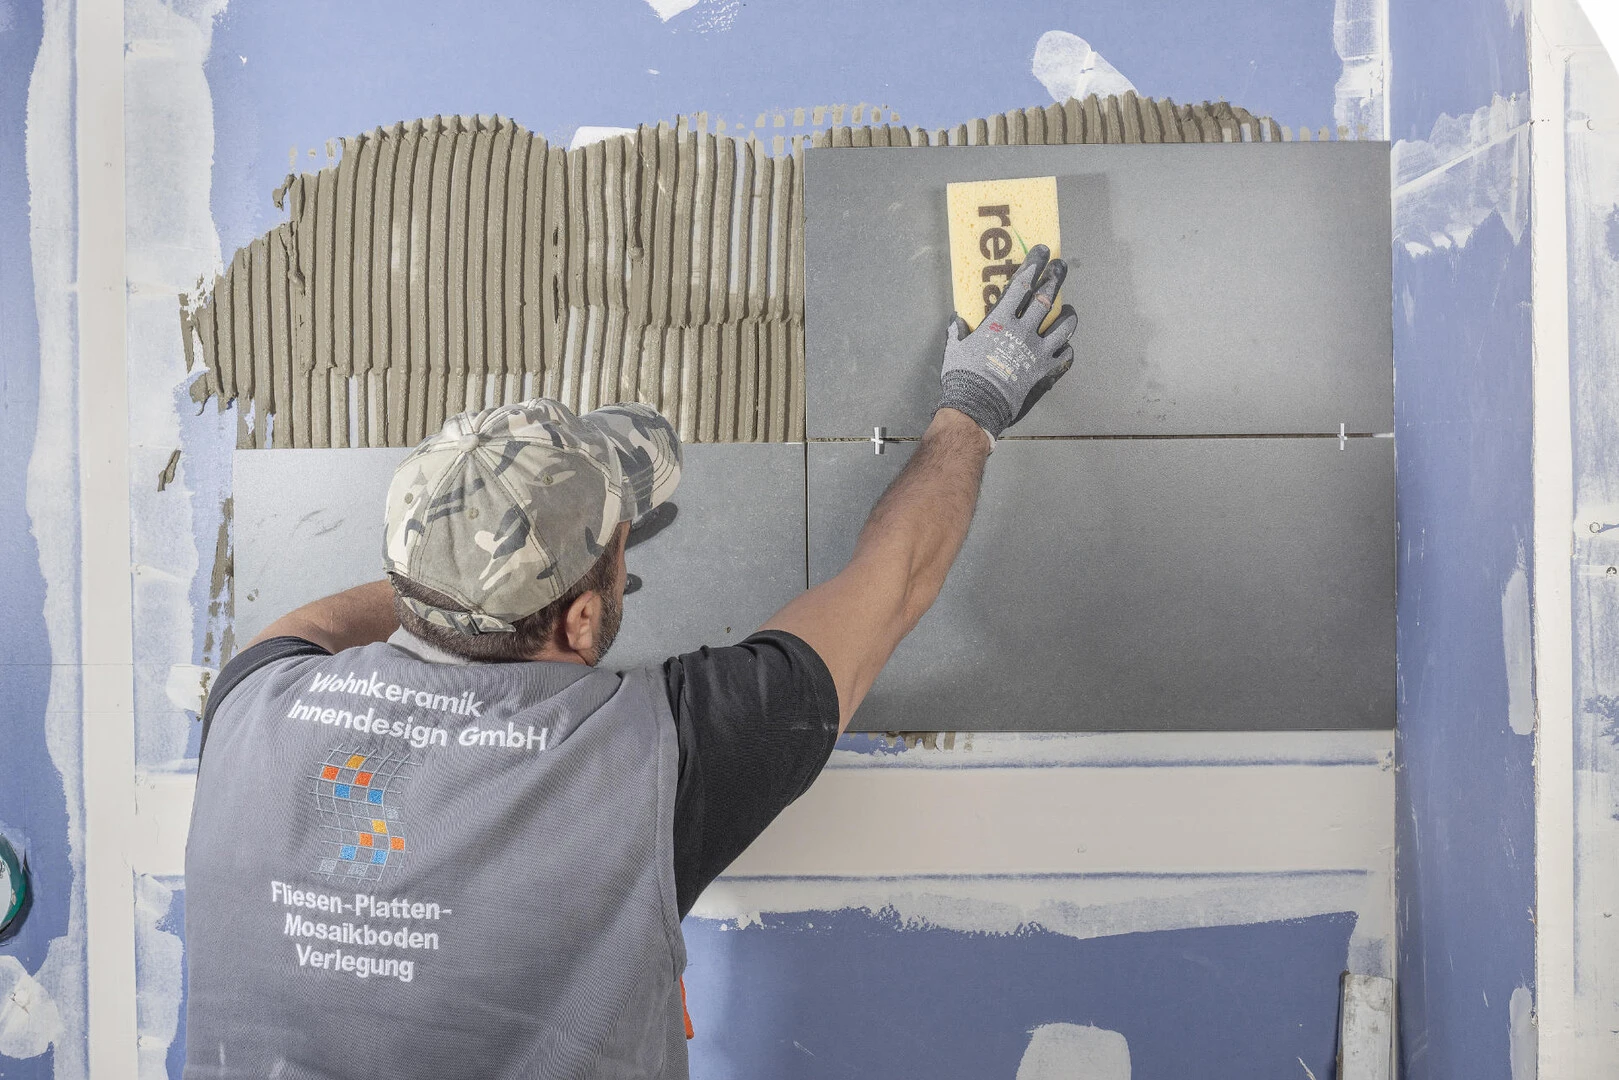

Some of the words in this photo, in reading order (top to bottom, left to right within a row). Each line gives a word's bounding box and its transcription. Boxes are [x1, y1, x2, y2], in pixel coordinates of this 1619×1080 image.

[308, 671, 484, 717] Wohnkeramik
[287, 699, 448, 748] Innendesign
[458, 722, 549, 751] GmbH
[270, 881, 452, 920] Fliesen-Platten-
[284, 912, 439, 950] Mosaikboden
[295, 943, 415, 983] Verlegung
